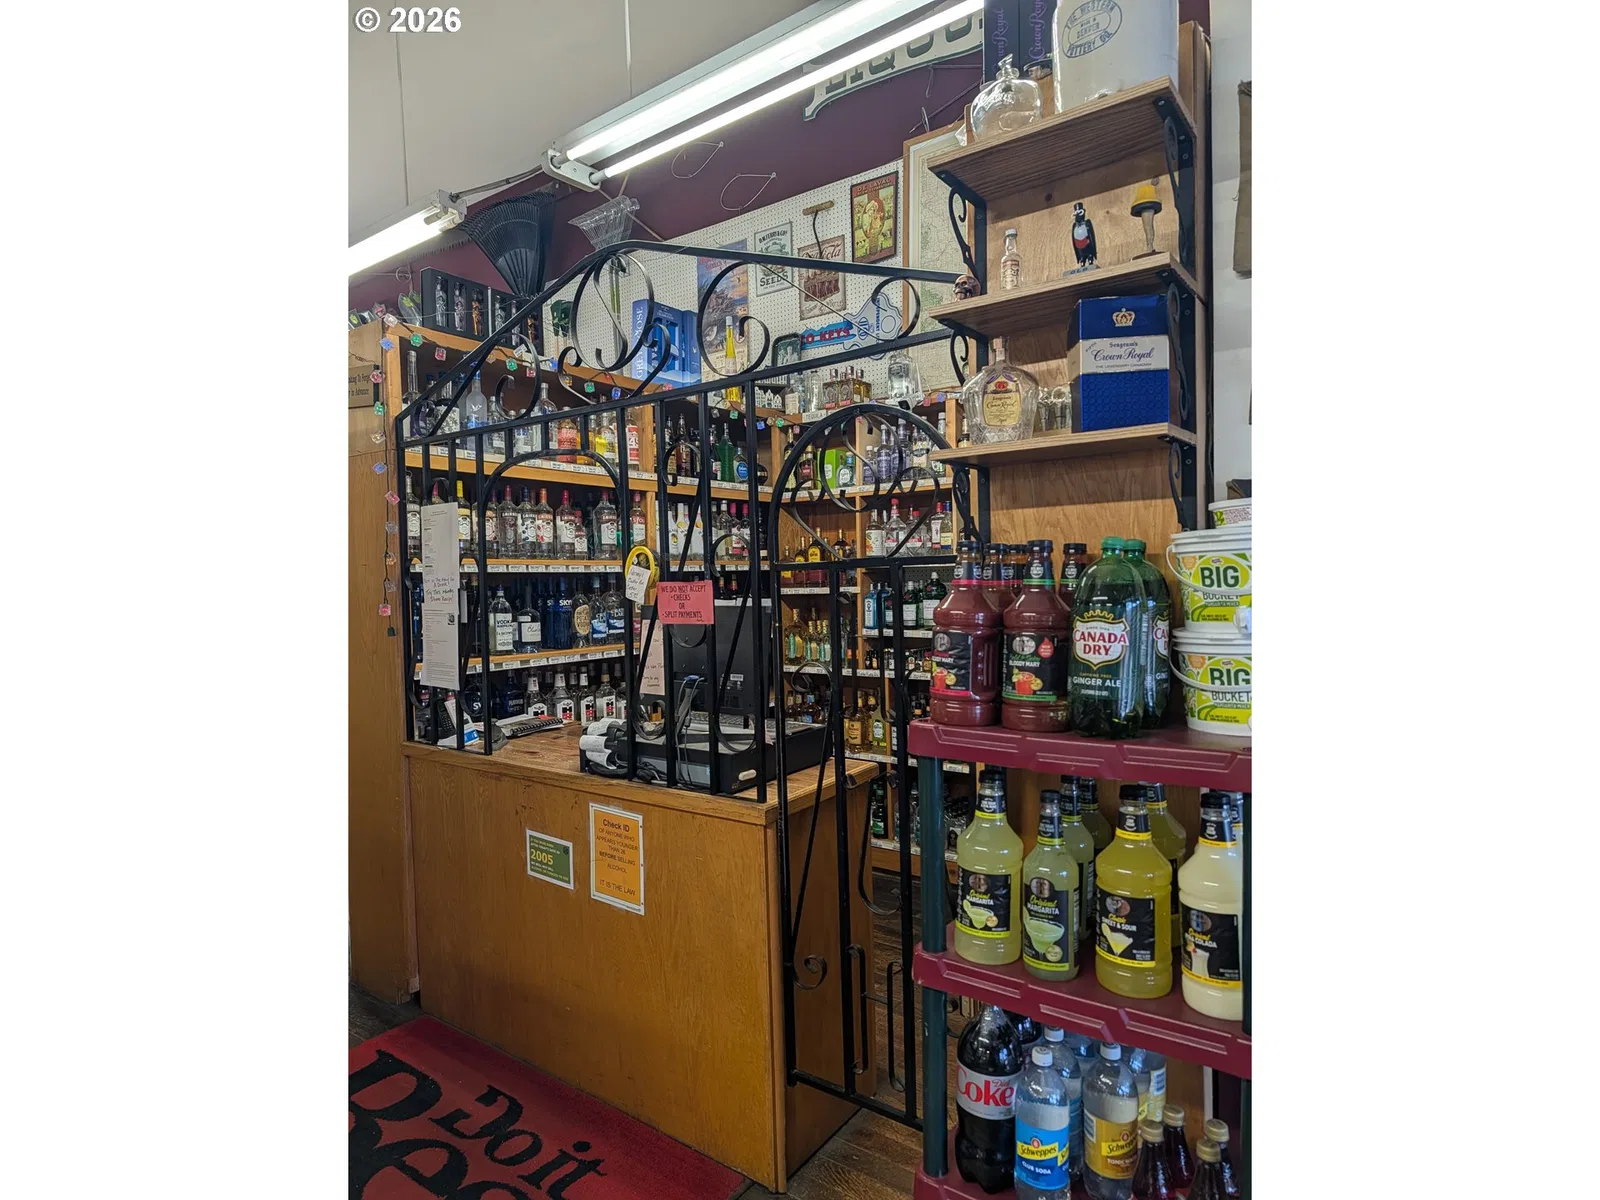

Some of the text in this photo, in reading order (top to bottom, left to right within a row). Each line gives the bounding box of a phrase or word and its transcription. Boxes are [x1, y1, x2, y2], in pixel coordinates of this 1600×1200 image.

[1029, 21, 1046, 59] Crown
[869, 178, 891, 188] LAVAL
[760, 271, 789, 287] SEEDS
[820, 327, 851, 340] KEYS
[1109, 341, 1138, 349] Seagram's
[1091, 347, 1155, 363] Crown Royal
[1200, 565, 1240, 588] BIG
[678, 585, 688, 593] NOT
[1073, 629, 1129, 645] CANADA
[1083, 644, 1112, 656] DRY
[1073, 676, 1122, 688] GINGER ALE
[1209, 667, 1251, 686] BIG
[1212, 690, 1250, 703] BUCKET
[603, 819, 630, 833] Check ID
[605, 830, 623, 839] ANYONE
[596, 835, 639, 850] APPEARS YOUNGER
[531, 849, 554, 865] 2005
[599, 851, 636, 866] BEFORE SELLING
[607, 863, 627, 873] ALCOHOL
[612, 882, 623, 892] THE
[623, 887, 636, 896] LAW
[969, 889, 991, 899] Original
[966, 895, 994, 905] MARGARITA
[1030, 895, 1058, 907] Original
[1027, 902, 1060, 915] MARGARITA
[1121, 924, 1137, 932] SOUR
[1195, 938, 1217, 948] COLADA
[956, 1064, 1015, 1107] Coke
[1020, 1144, 1057, 1158] Schweppes
[1022, 1161, 1052, 1175] CLUB SODA
